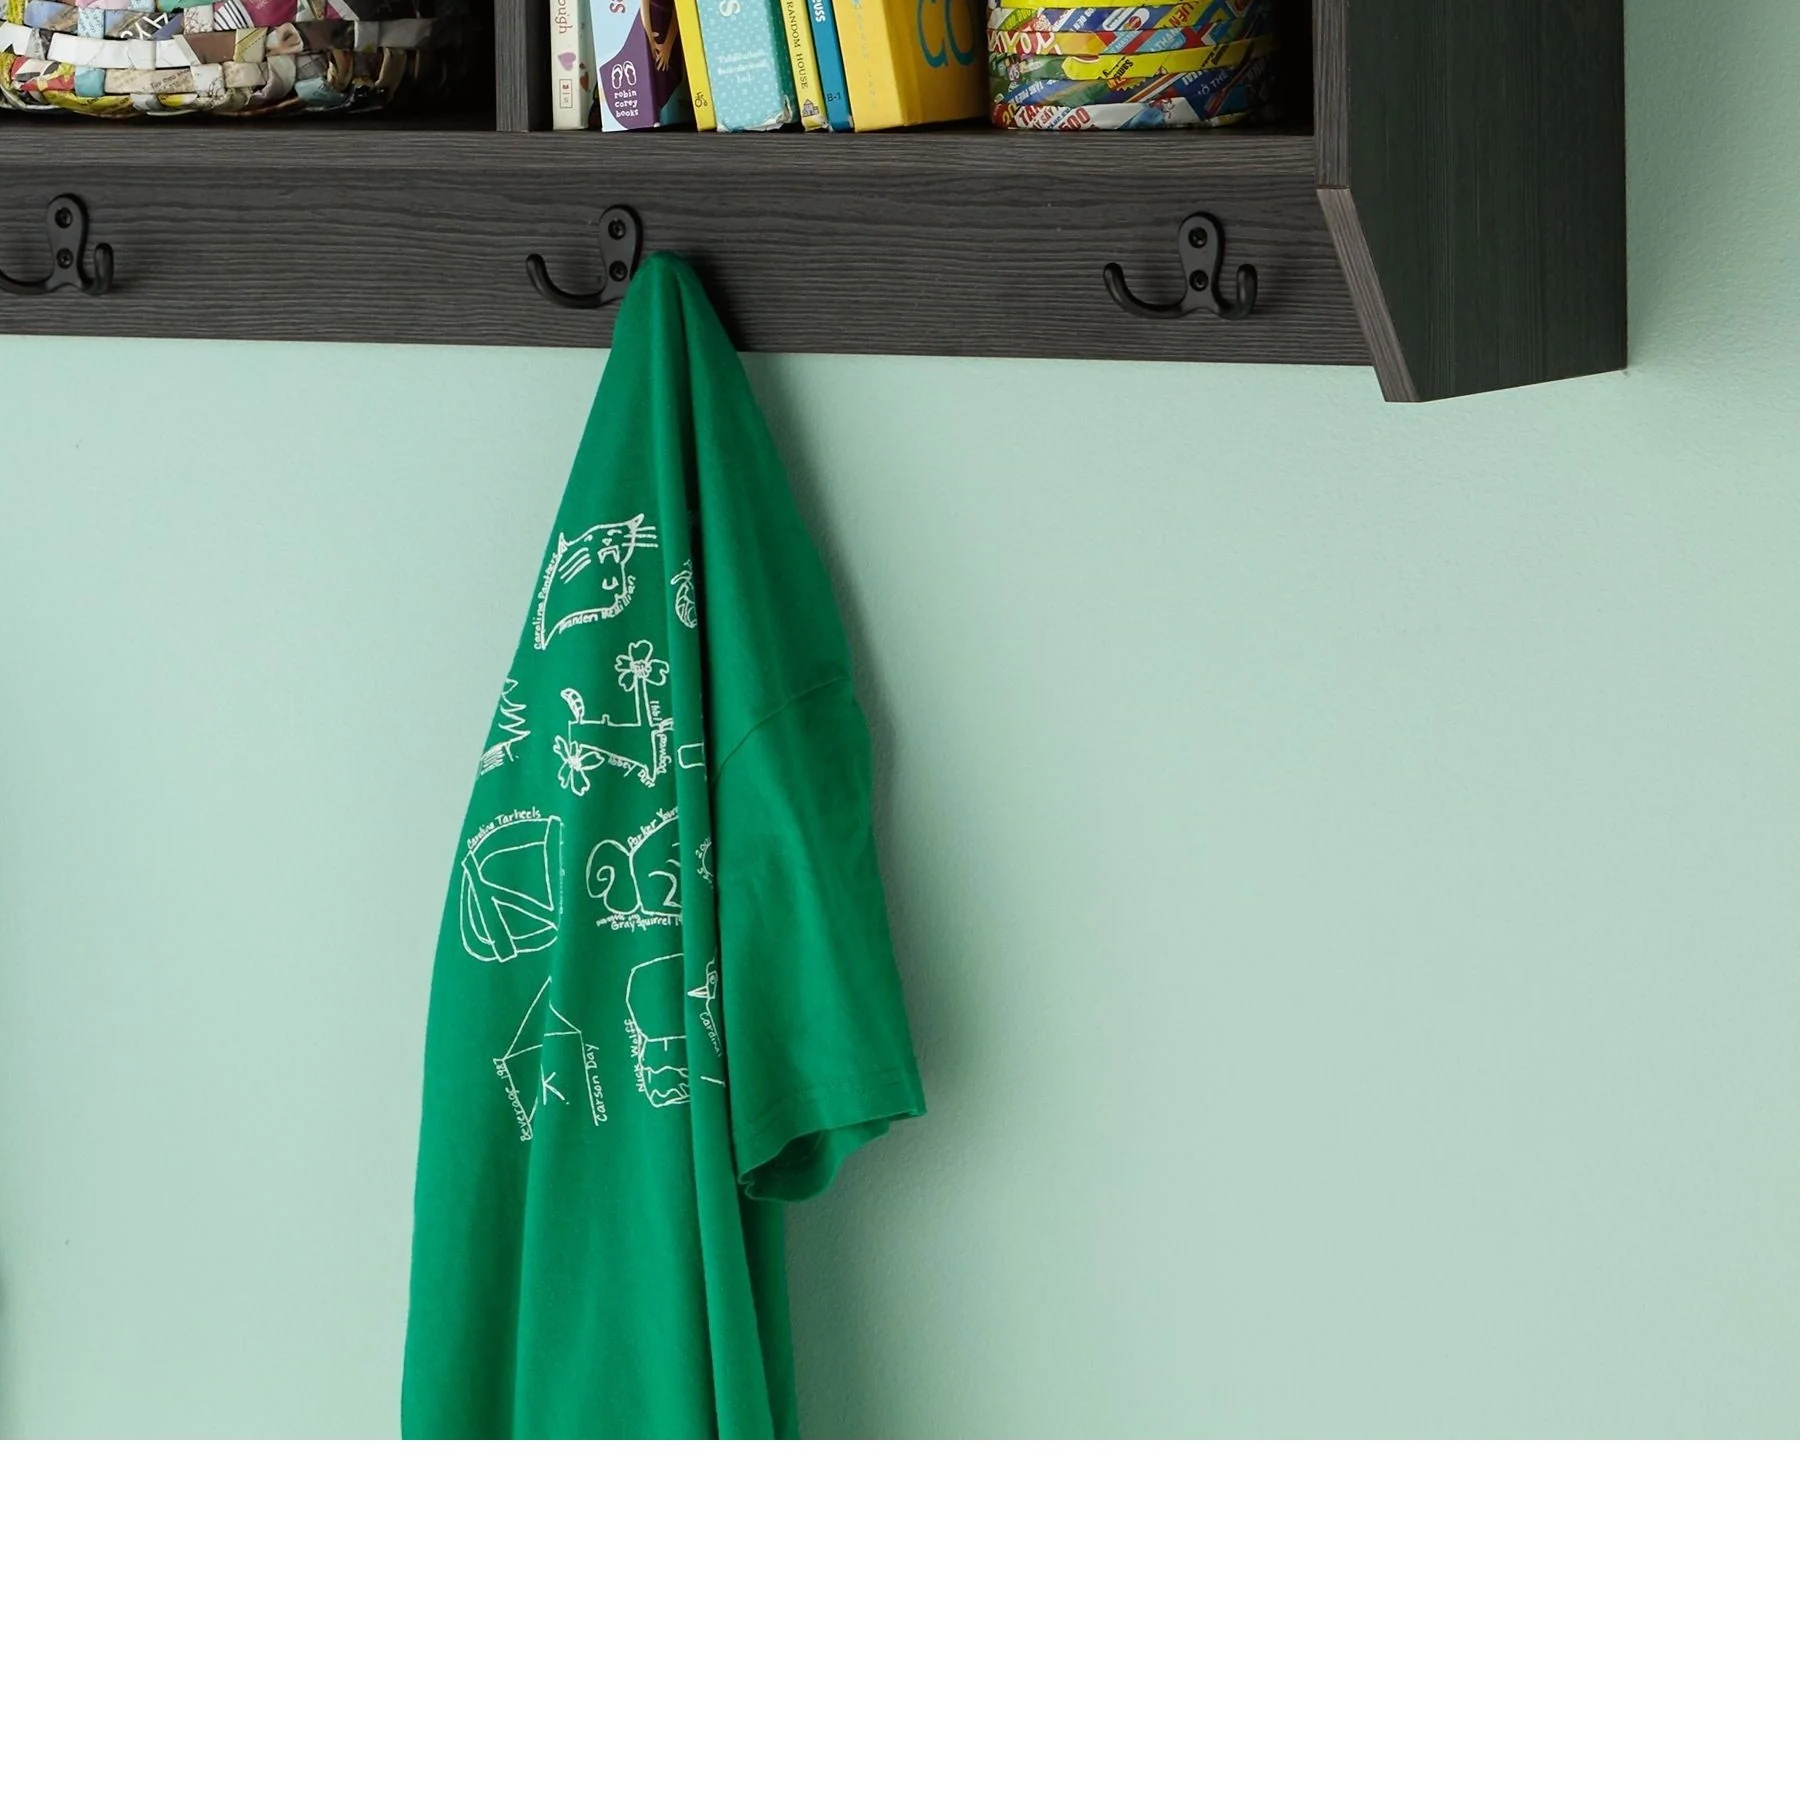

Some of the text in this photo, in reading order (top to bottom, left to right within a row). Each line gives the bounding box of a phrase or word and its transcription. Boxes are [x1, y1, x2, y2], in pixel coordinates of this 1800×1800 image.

[786, 1, 801, 48] RANDOM
[796, 52, 809, 89] HOUSE
[614, 88, 638, 100] robin
[614, 99, 638, 111] corey
[616, 107, 639, 118] books
[656, 730, 672, 774] Dogwood
[466, 806, 541, 848] Carolina Tarheels
[611, 918, 636, 933] Gray
[624, 1018, 647, 1093] Nick Wolff
[492, 1057, 533, 1142] Beverage 1987
[585, 1043, 608, 1123] Carson Day
